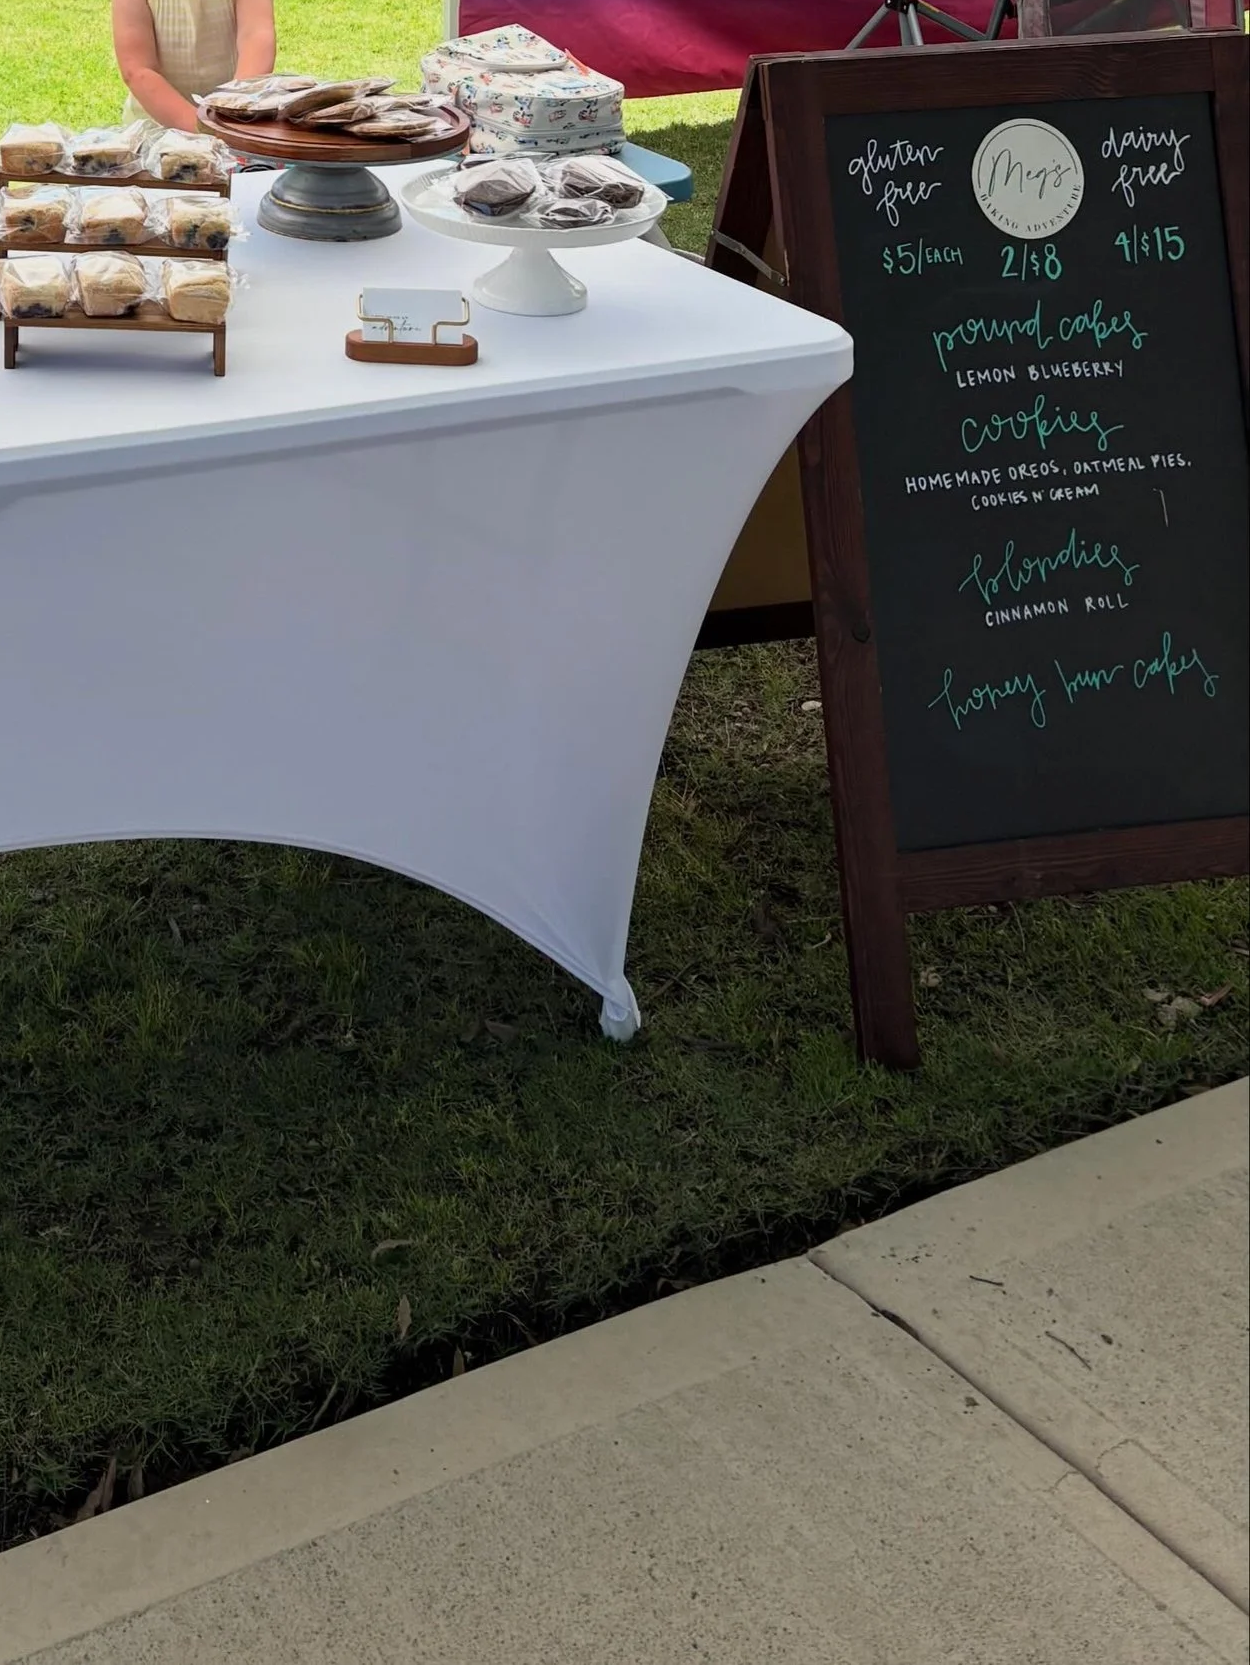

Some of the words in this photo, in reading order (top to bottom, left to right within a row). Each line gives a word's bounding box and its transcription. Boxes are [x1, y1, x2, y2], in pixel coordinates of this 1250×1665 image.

[848, 139, 944, 195] gluten
[1102, 126, 1190, 172] dairy
[988, 149, 1071, 200] Meg's
[1112, 161, 1182, 208] free
[875, 180, 942, 227] free
[980, 193, 1018, 229] BAKING
[1026, 184, 1081, 232] ADVENTURE
[1000, 243, 1063, 281] 2/$8
[1114, 225, 1185, 264] 4/$15
[933, 300, 1054, 372] pound
[1059, 300, 1148, 349] cakes
[956, 365, 1016, 389] LEMON
[1028, 360, 1124, 382] BLUEBERRY
[961, 394, 1125, 452] cookies
[905, 466, 1001, 494] HOMEMADE
[1073, 456, 1146, 474] OATMEAL
[971, 489, 1028, 511] COOKIES
[1049, 484, 1100, 502] CREAM
[958, 528, 1141, 605] blondies
[985, 598, 1069, 627] CINNAMON
[1084, 593, 1129, 613] ROLL
[928, 667, 1047, 730] honey
[1054, 659, 1125, 703] bun
[1133, 632, 1220, 697] cakes
